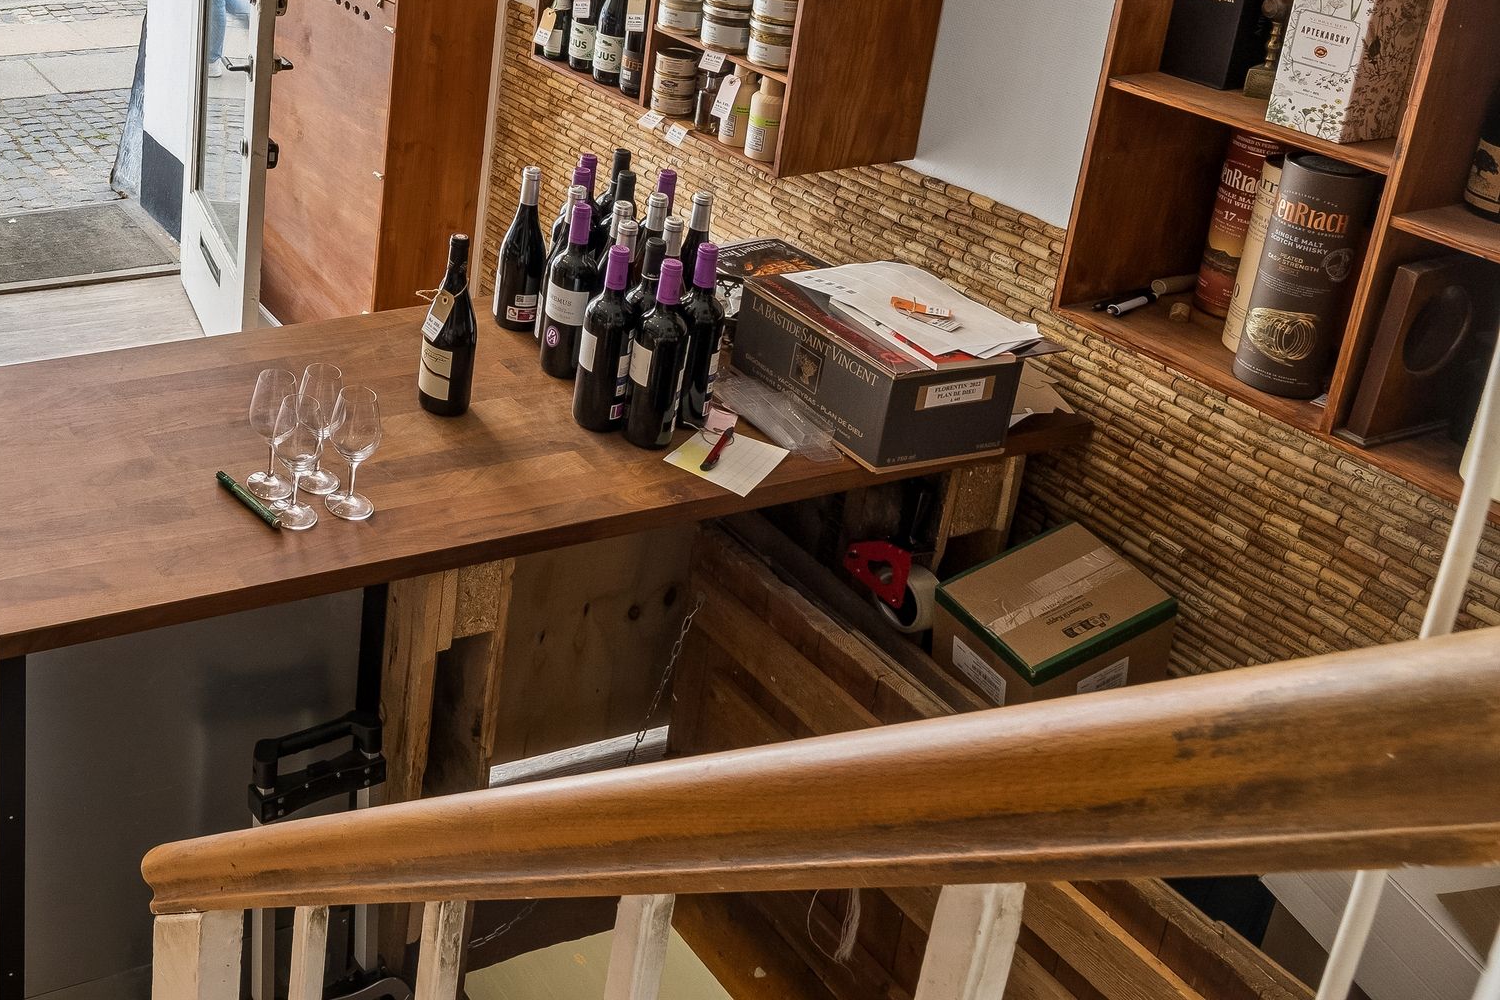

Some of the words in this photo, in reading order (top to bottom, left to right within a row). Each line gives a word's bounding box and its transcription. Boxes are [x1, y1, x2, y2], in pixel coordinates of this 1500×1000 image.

[1300, 25, 1351, 45] APTEKARSKY
[1223, 209, 1237, 222] 17
[1270, 232, 1294, 248] SCOTCH
[1294, 242, 1329, 256] WHISKY
[1275, 228, 1300, 243] SINGLE
[1301, 238, 1324, 249] MALT
[1280, 252, 1304, 264] PEATED
[1281, 259, 1320, 273] STRENGTH
[752, 296, 765, 314] LA
[764, 304, 802, 339] BASTIDE
[801, 326, 835, 356] SAINT
[830, 345, 880, 387] VINCENT
[934, 382, 968, 393] FLORENTIN
[969, 381, 982, 389] 2022
[937, 391, 951, 399] PLAN
[961, 388, 977, 396] DIEU
[820, 404, 838, 420] PLAN
[837, 416, 847, 428] DE
[847, 423, 864, 438] DIEU
